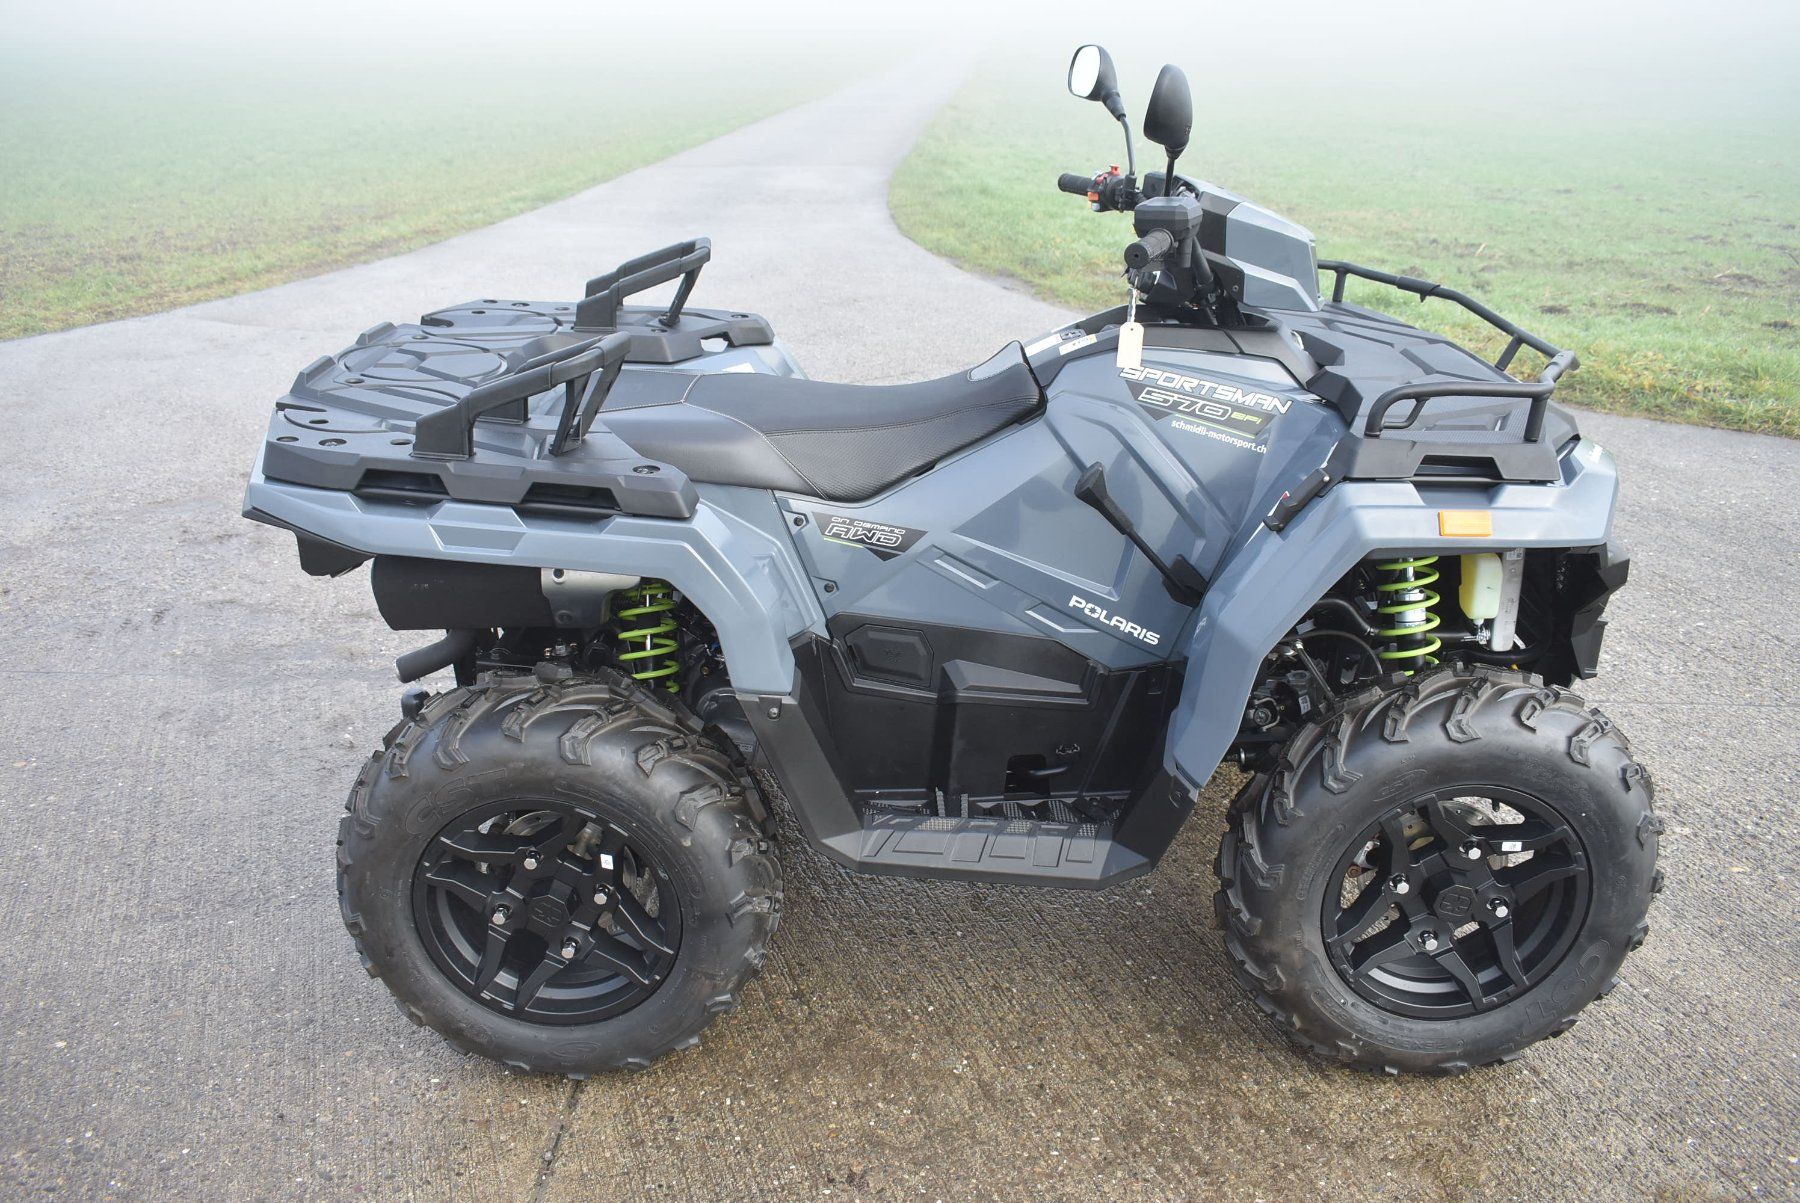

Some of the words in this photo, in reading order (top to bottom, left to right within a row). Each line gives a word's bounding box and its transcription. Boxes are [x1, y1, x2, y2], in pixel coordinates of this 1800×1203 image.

[1119, 366, 1293, 414] SPORTSMAN
[1138, 387, 1232, 421] 570
[1231, 411, 1262, 425] EFI
[1171, 420, 1267, 454] schmidli-motorsport.ch
[824, 523, 902, 547] AWD
[1068, 595, 1160, 645] POLARIS
